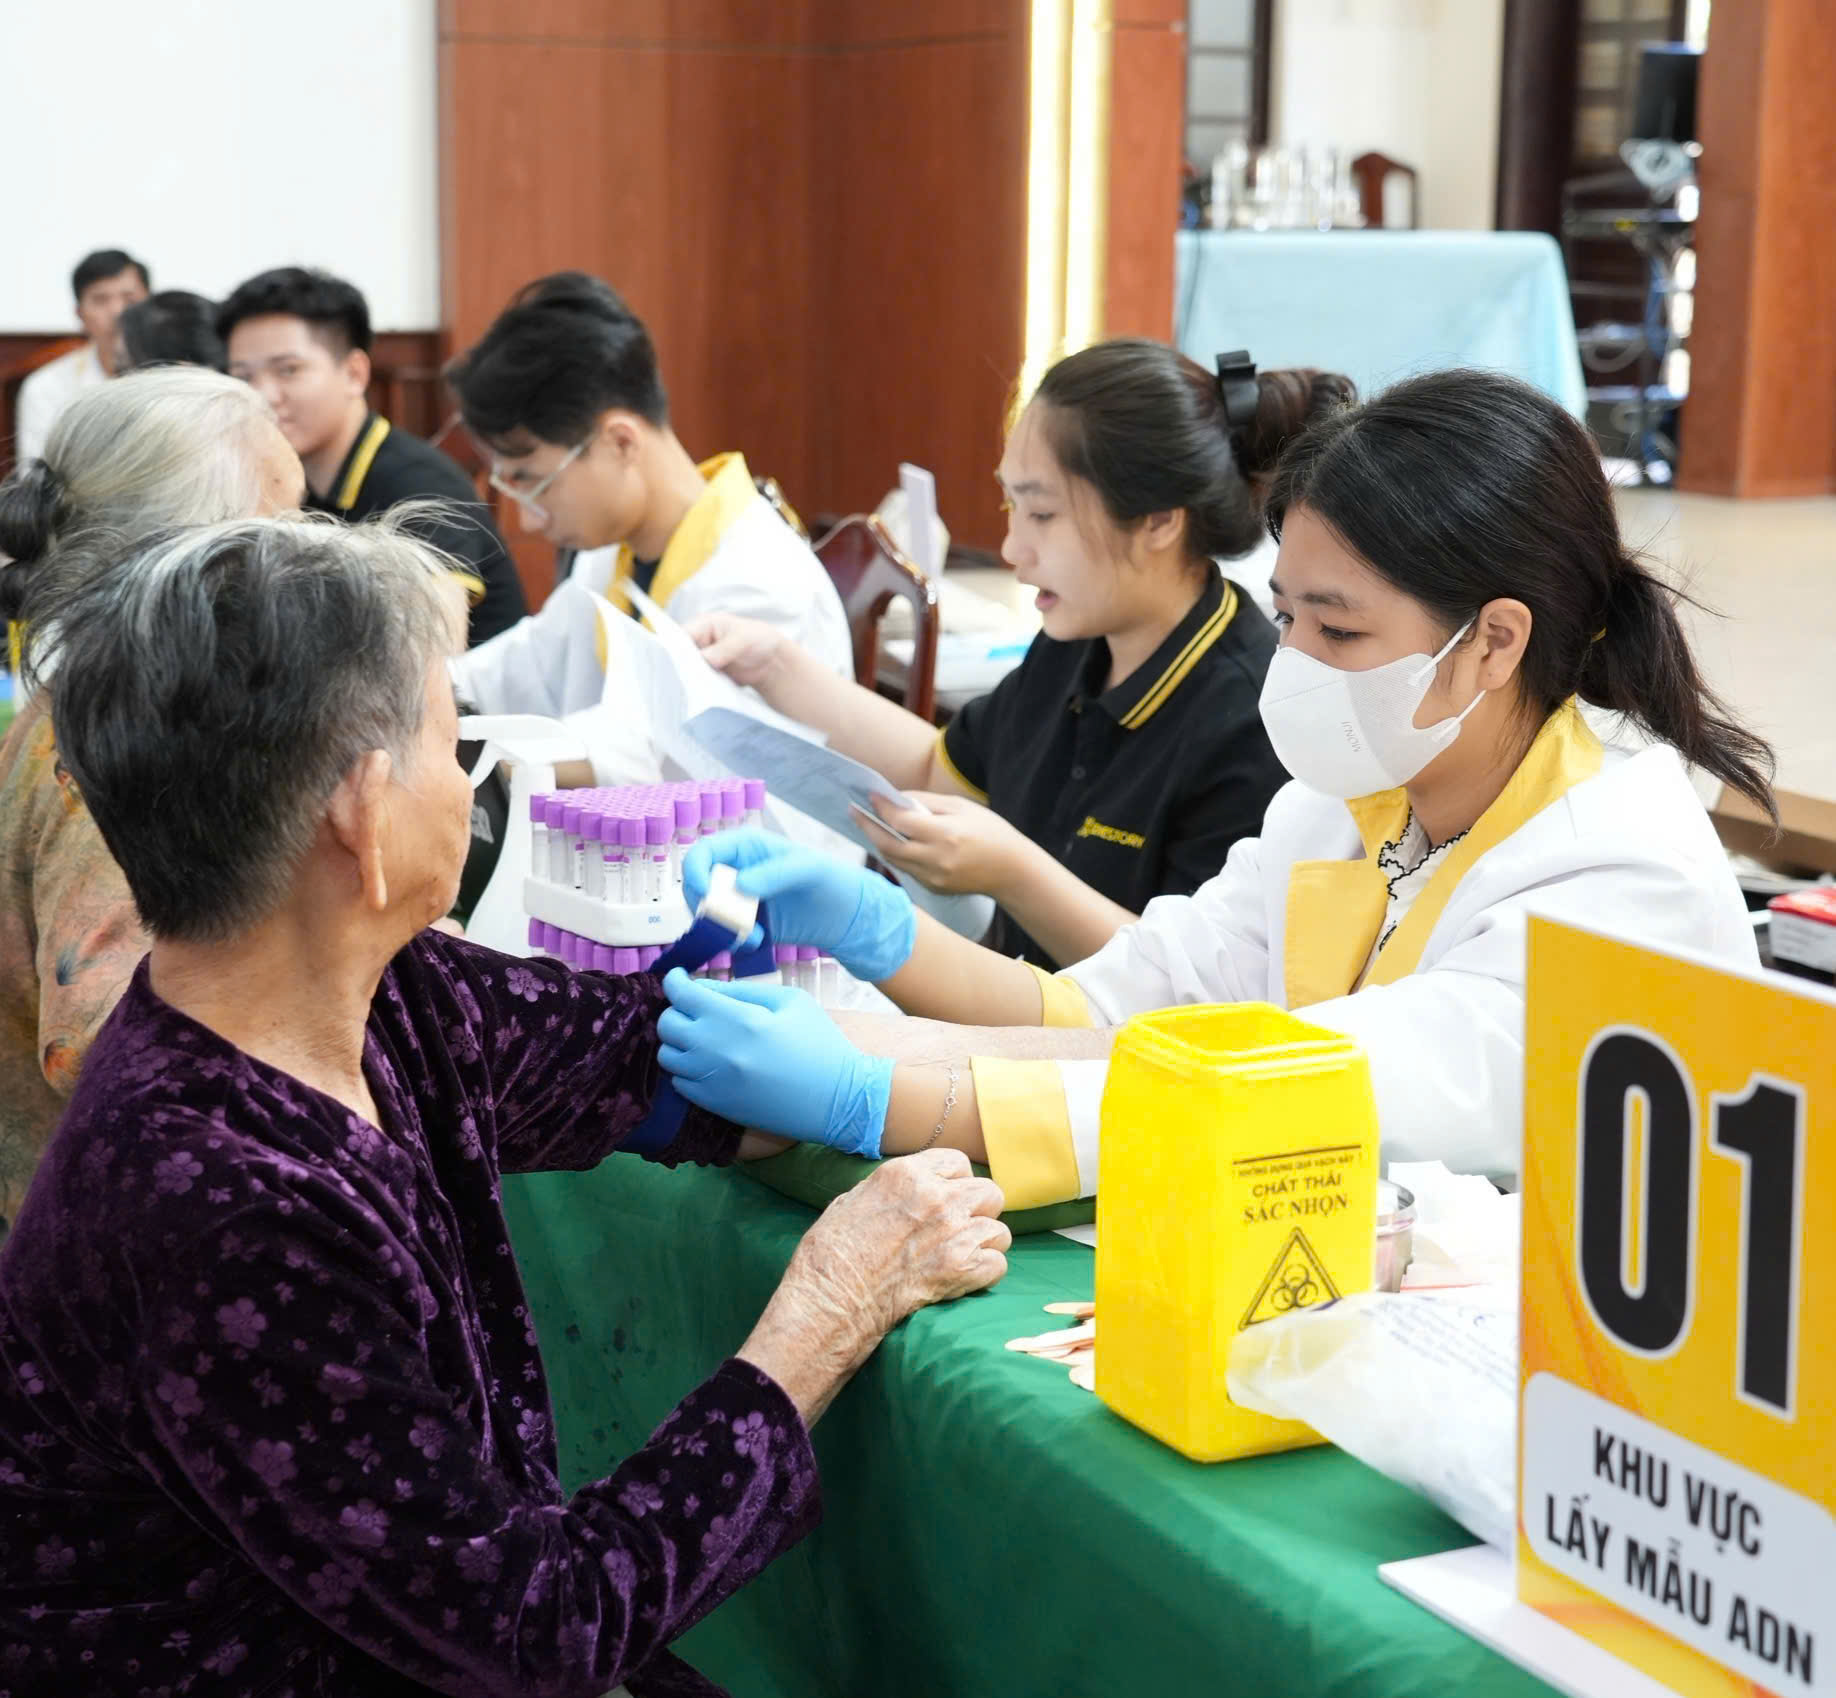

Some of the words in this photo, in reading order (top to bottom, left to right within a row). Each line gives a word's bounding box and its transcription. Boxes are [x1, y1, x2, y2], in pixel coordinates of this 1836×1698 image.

[1290, 1194, 1348, 1217] NHỌN
[1577, 1027, 1803, 1418] 01
[1594, 1425, 1668, 1508] KHU
[1683, 1471, 1762, 1557] VỰC
[1546, 1492, 1611, 1571] LẤY
[1625, 1535, 1713, 1627] MẪU
[1728, 1593, 1814, 1686] ADN
